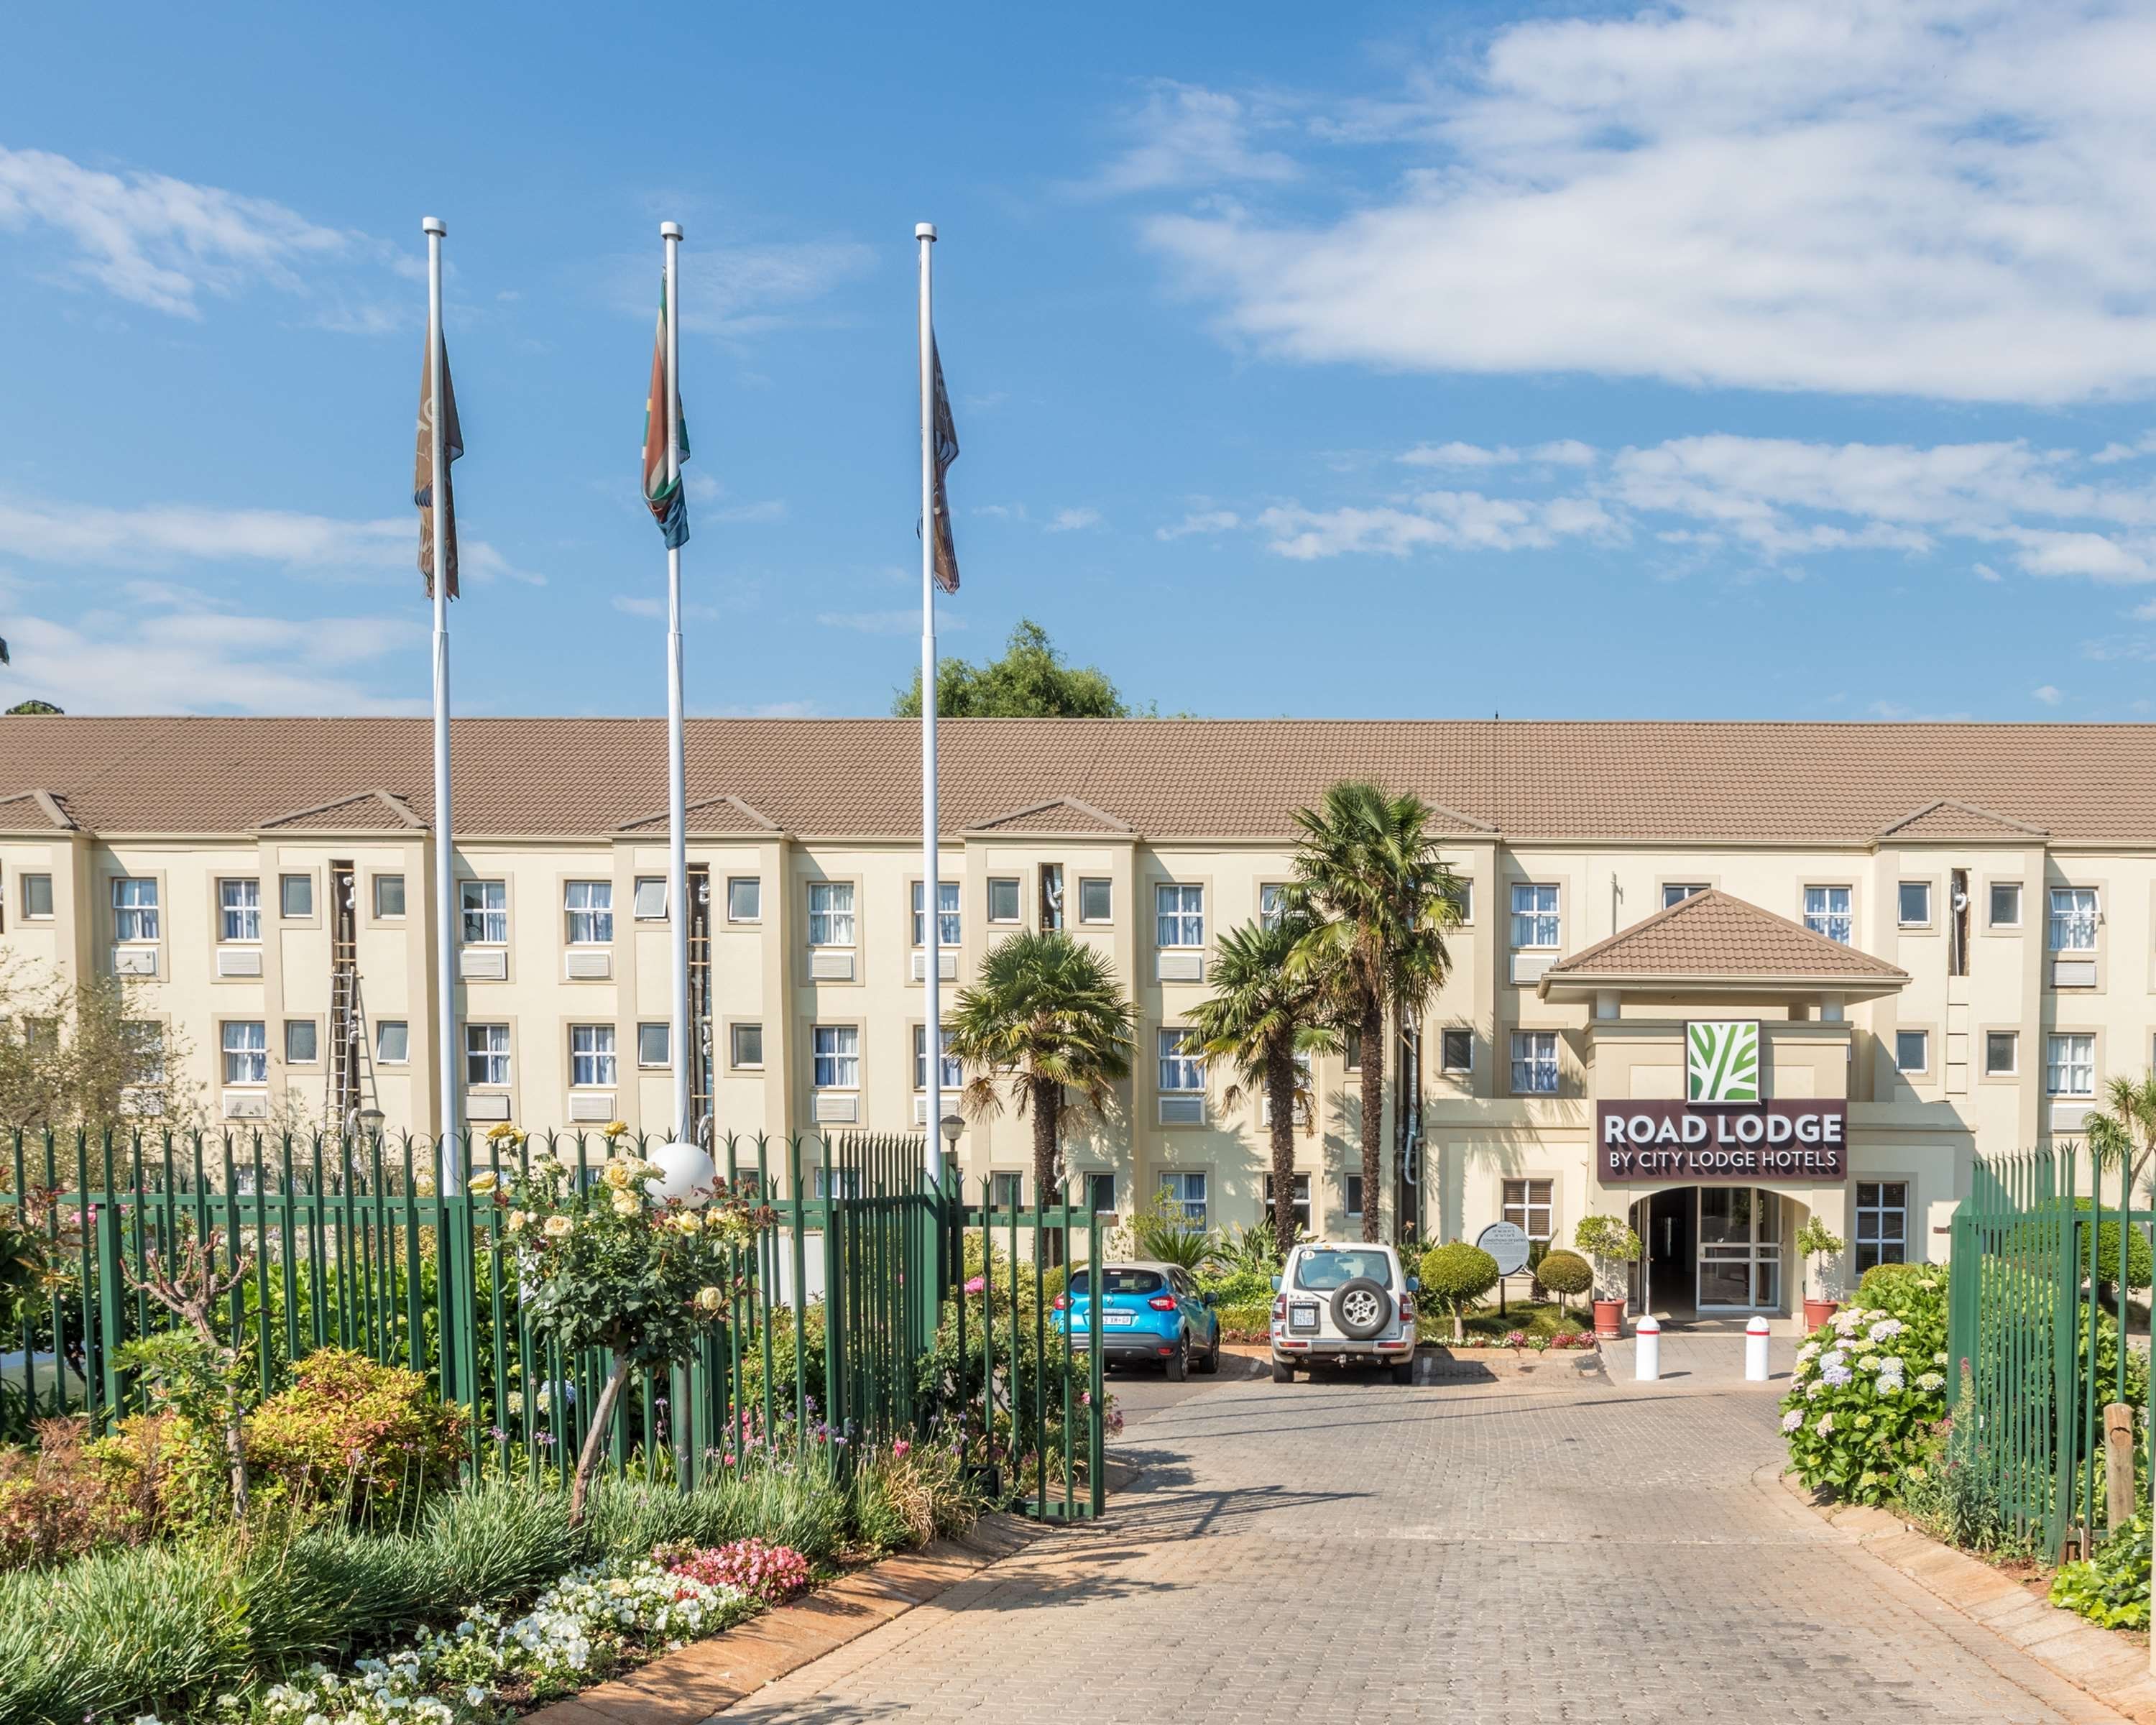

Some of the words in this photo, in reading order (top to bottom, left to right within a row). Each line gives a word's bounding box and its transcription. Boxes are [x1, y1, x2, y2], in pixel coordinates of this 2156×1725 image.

[1605, 1115, 1707, 1143] ROAD
[1718, 1114, 1841, 1143] LODGE
[1610, 1151, 1632, 1167] BY
[1639, 1151, 1682, 1167] CITY
[1690, 1151, 1755, 1167] LODGE
[1762, 1151, 1836, 1167] HOTELS
